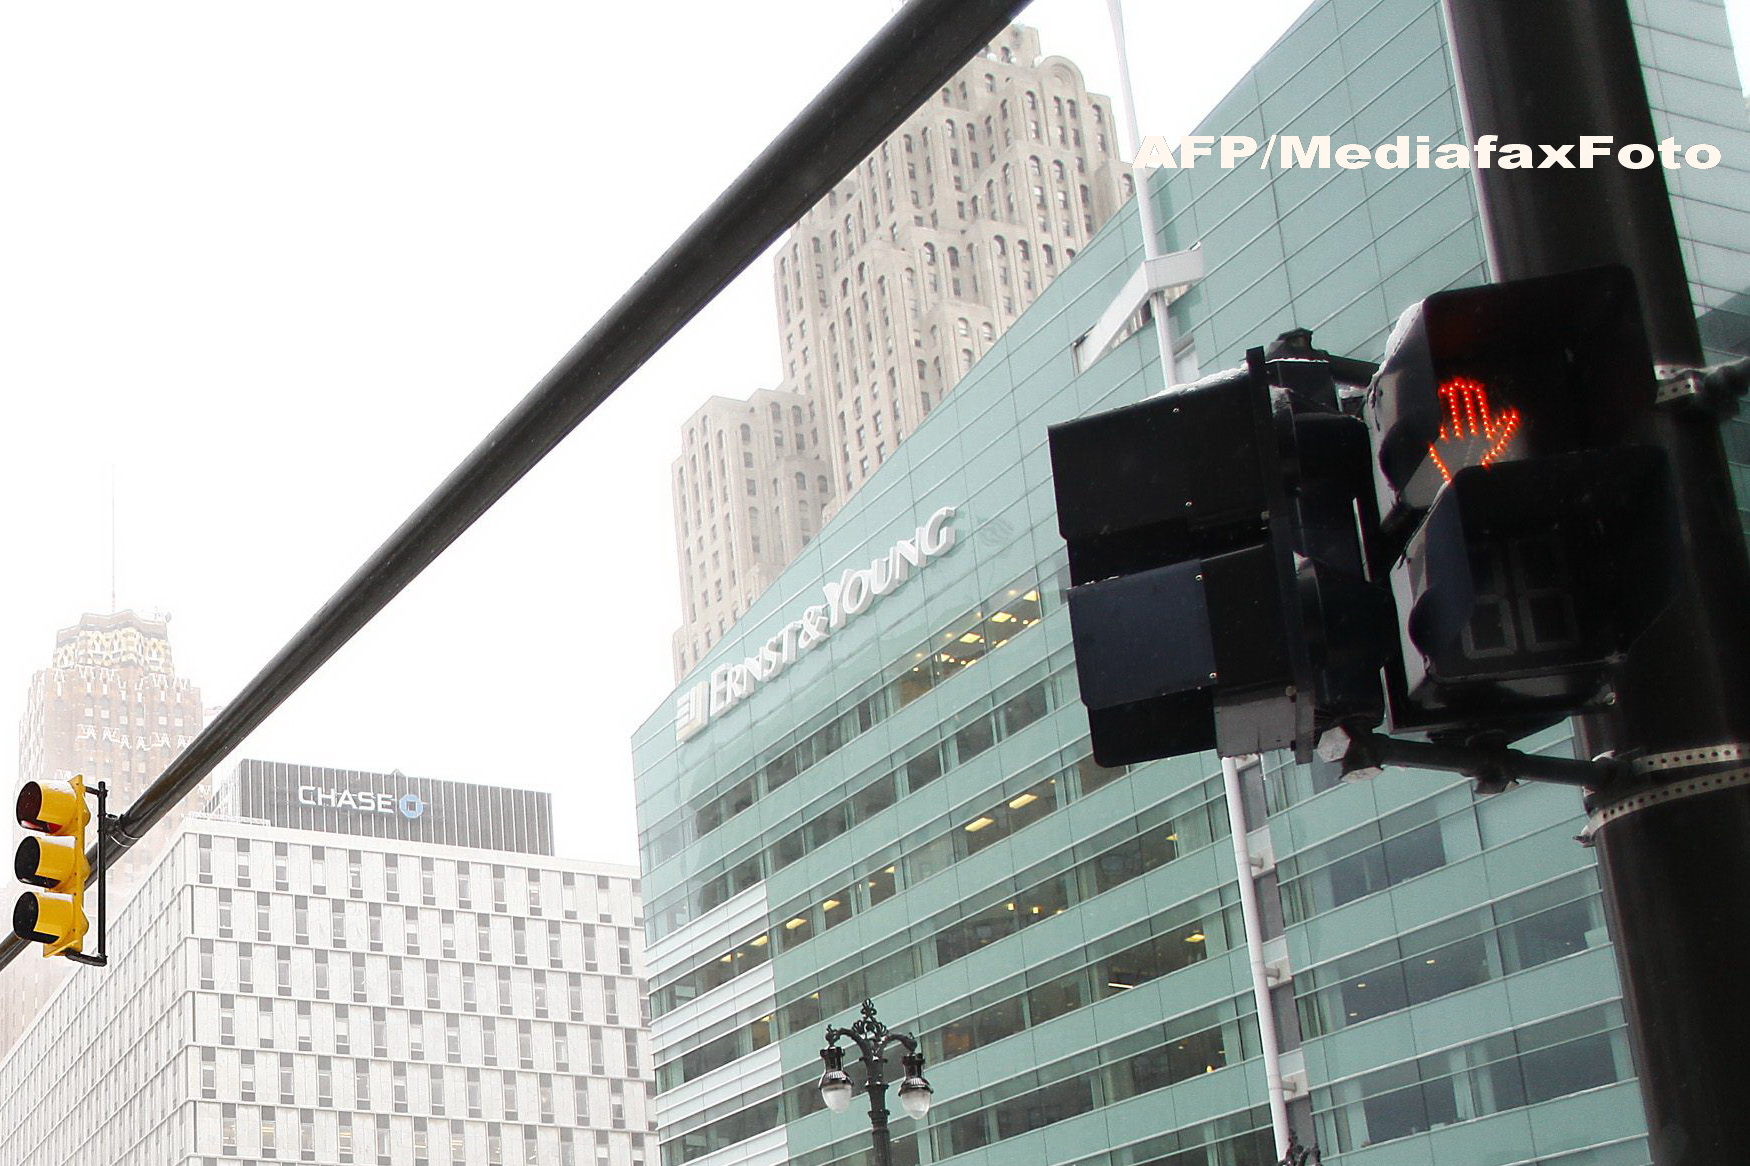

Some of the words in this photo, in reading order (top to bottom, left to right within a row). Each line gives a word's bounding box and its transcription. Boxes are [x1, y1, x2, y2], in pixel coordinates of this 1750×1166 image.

[710, 620, 803, 717] ERNST
[799, 603, 831, 650] &
[823, 506, 957, 629] YOUNG
[298, 785, 395, 814] CHASE
